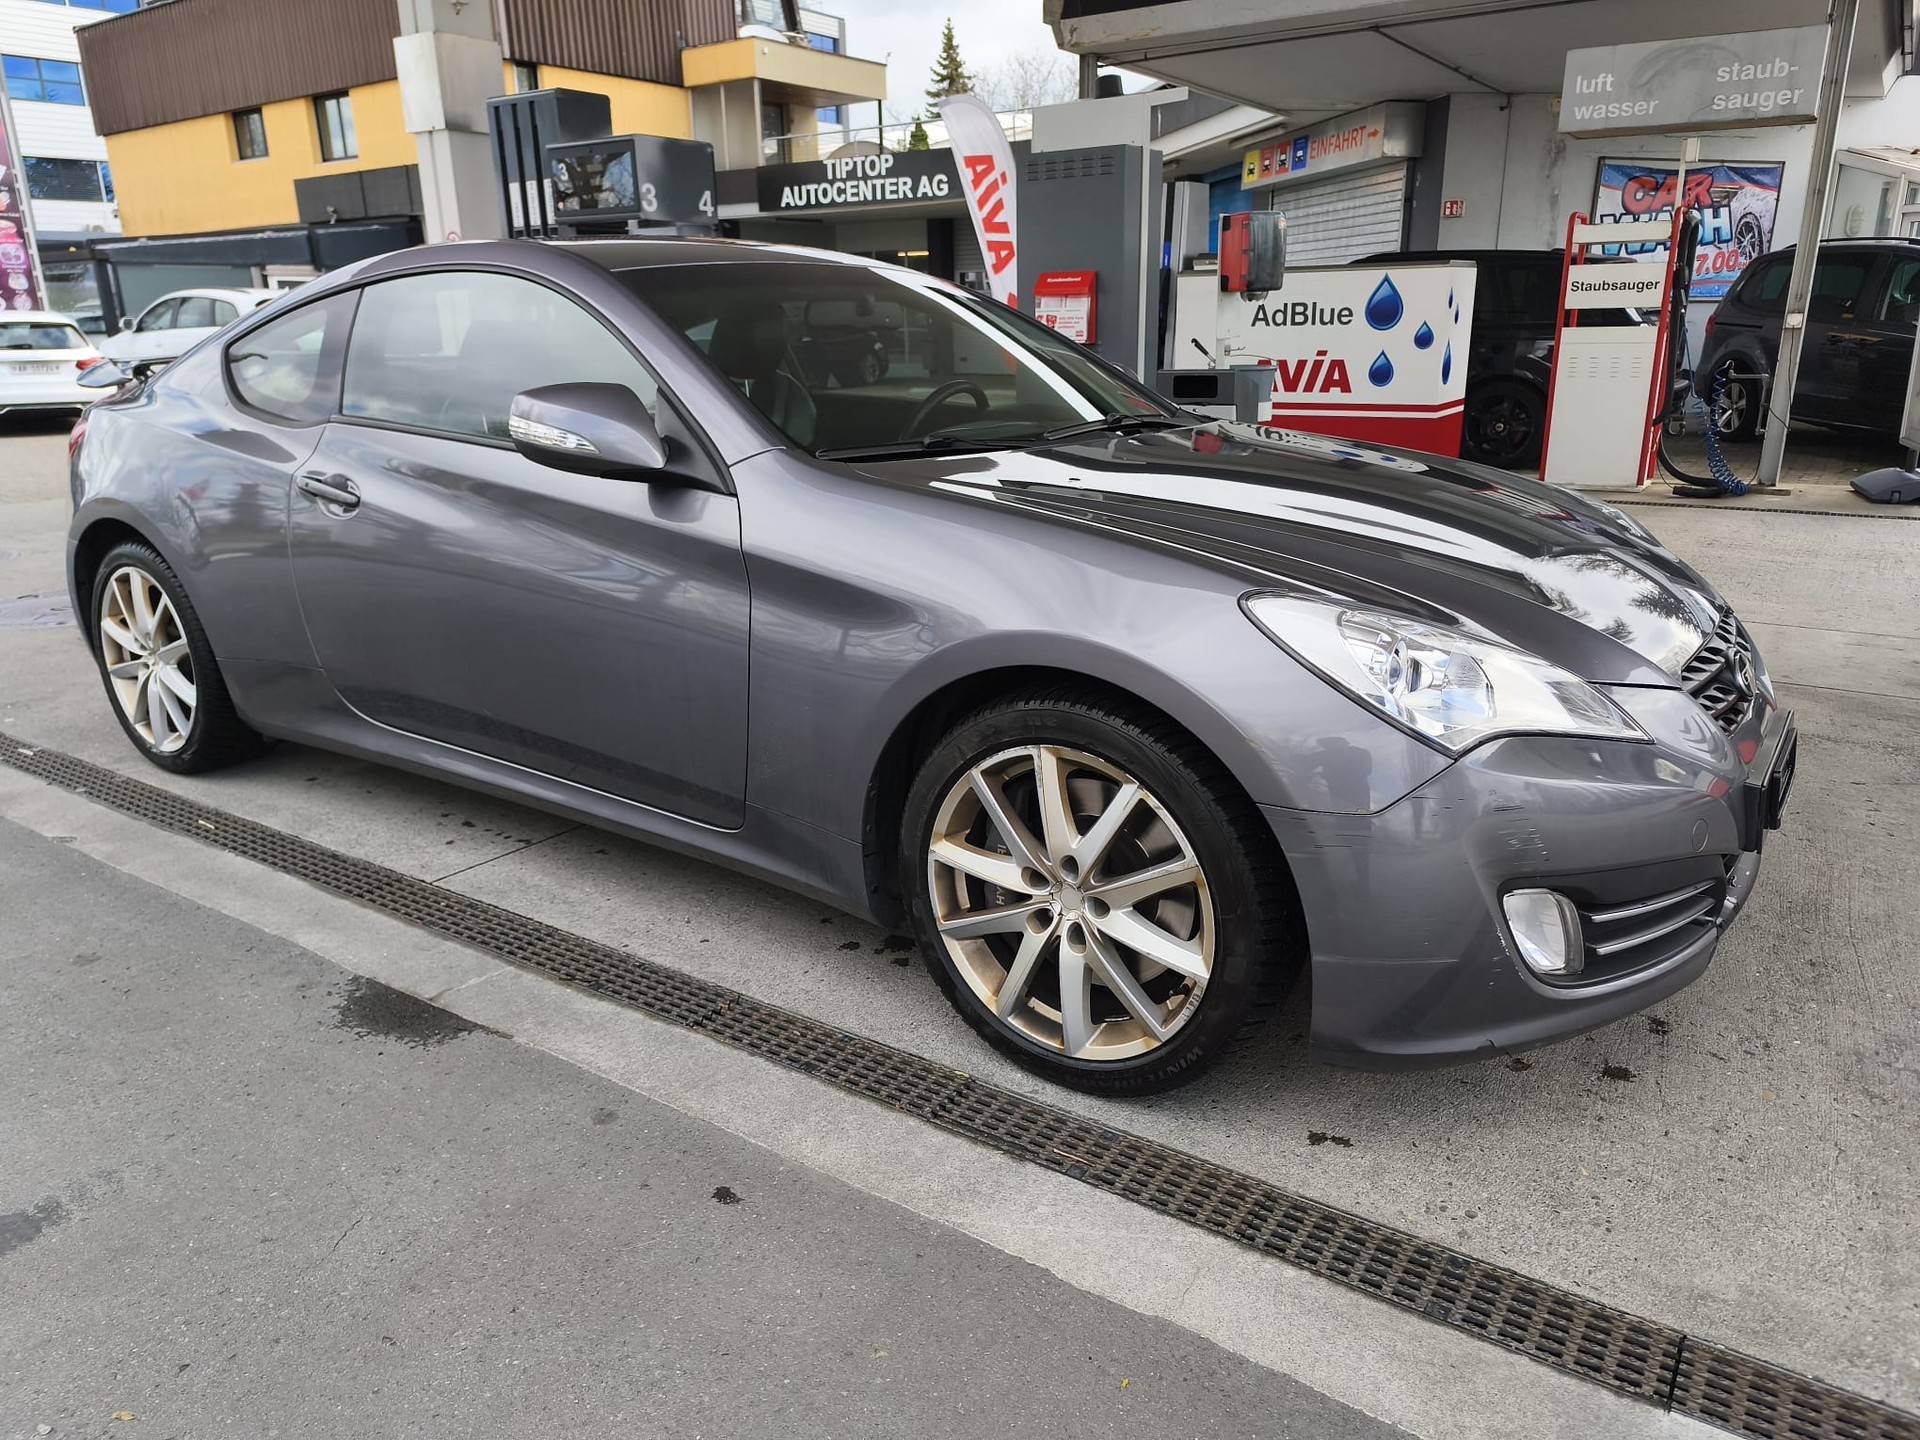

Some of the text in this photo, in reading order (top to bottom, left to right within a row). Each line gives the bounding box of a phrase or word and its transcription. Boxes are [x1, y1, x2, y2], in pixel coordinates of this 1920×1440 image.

[1716, 57, 1799, 83] staub-
[1575, 73, 1614, 94] luft
[1573, 99, 1660, 121] wasser
[1711, 86, 1805, 112] sauger
[1309, 125, 1367, 160] EINFAHRT
[557, 162, 569, 181] 3
[823, 154, 894, 180] TIPTOP
[641, 183, 658, 213] 3
[698, 189, 715, 218] 4
[780, 173, 949, 208] AUTOCENTER AG
[1621, 172, 1714, 215] CAR
[1600, 205, 1734, 256] WAH
[1570, 280, 1661, 293] Staubsauger
[1250, 302, 1354, 327] AdBlue
[1256, 350, 1353, 394] VIA
